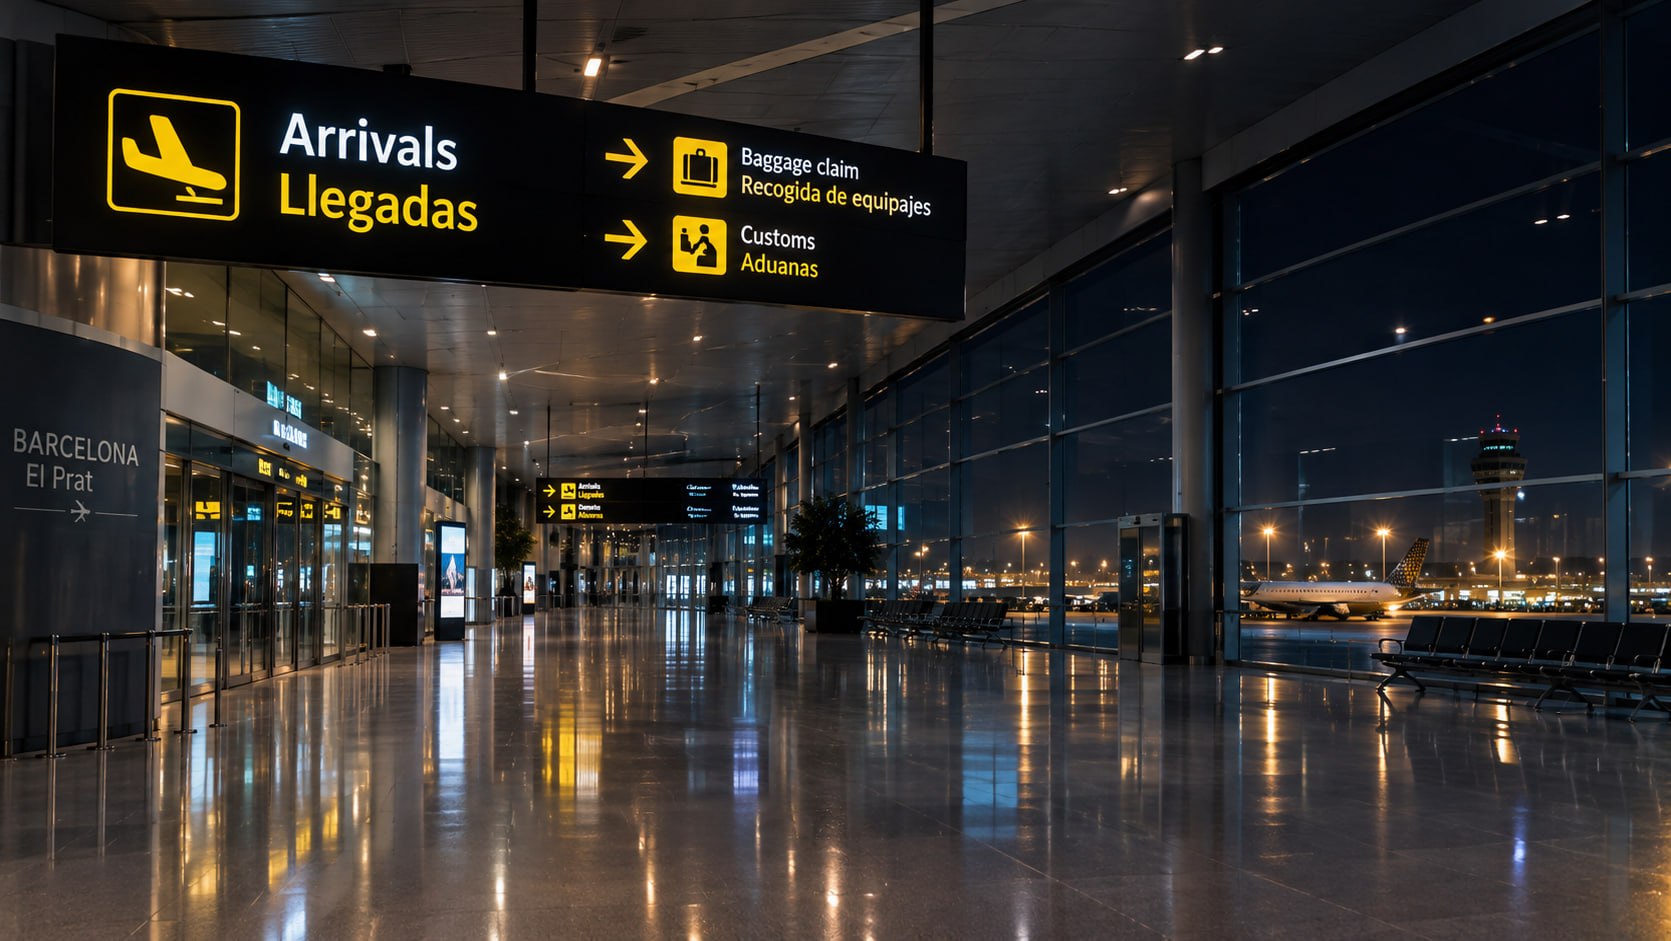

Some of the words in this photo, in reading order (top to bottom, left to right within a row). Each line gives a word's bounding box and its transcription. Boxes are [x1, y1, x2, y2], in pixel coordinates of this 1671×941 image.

[280, 112, 458, 171] Arrivals
[741, 147, 812, 176] Baggage
[816, 157, 860, 180] claim
[280, 172, 478, 233] Llegadas
[741, 174, 821, 204] Recogida
[826, 185, 847, 206] de
[852, 191, 932, 218] equipajes
[740, 225, 816, 250] Customs
[740, 252, 819, 278] Aduanas
[13, 427, 139, 467] BARCELONA
[26, 462, 45, 488] El
[53, 465, 93, 492] Prat
